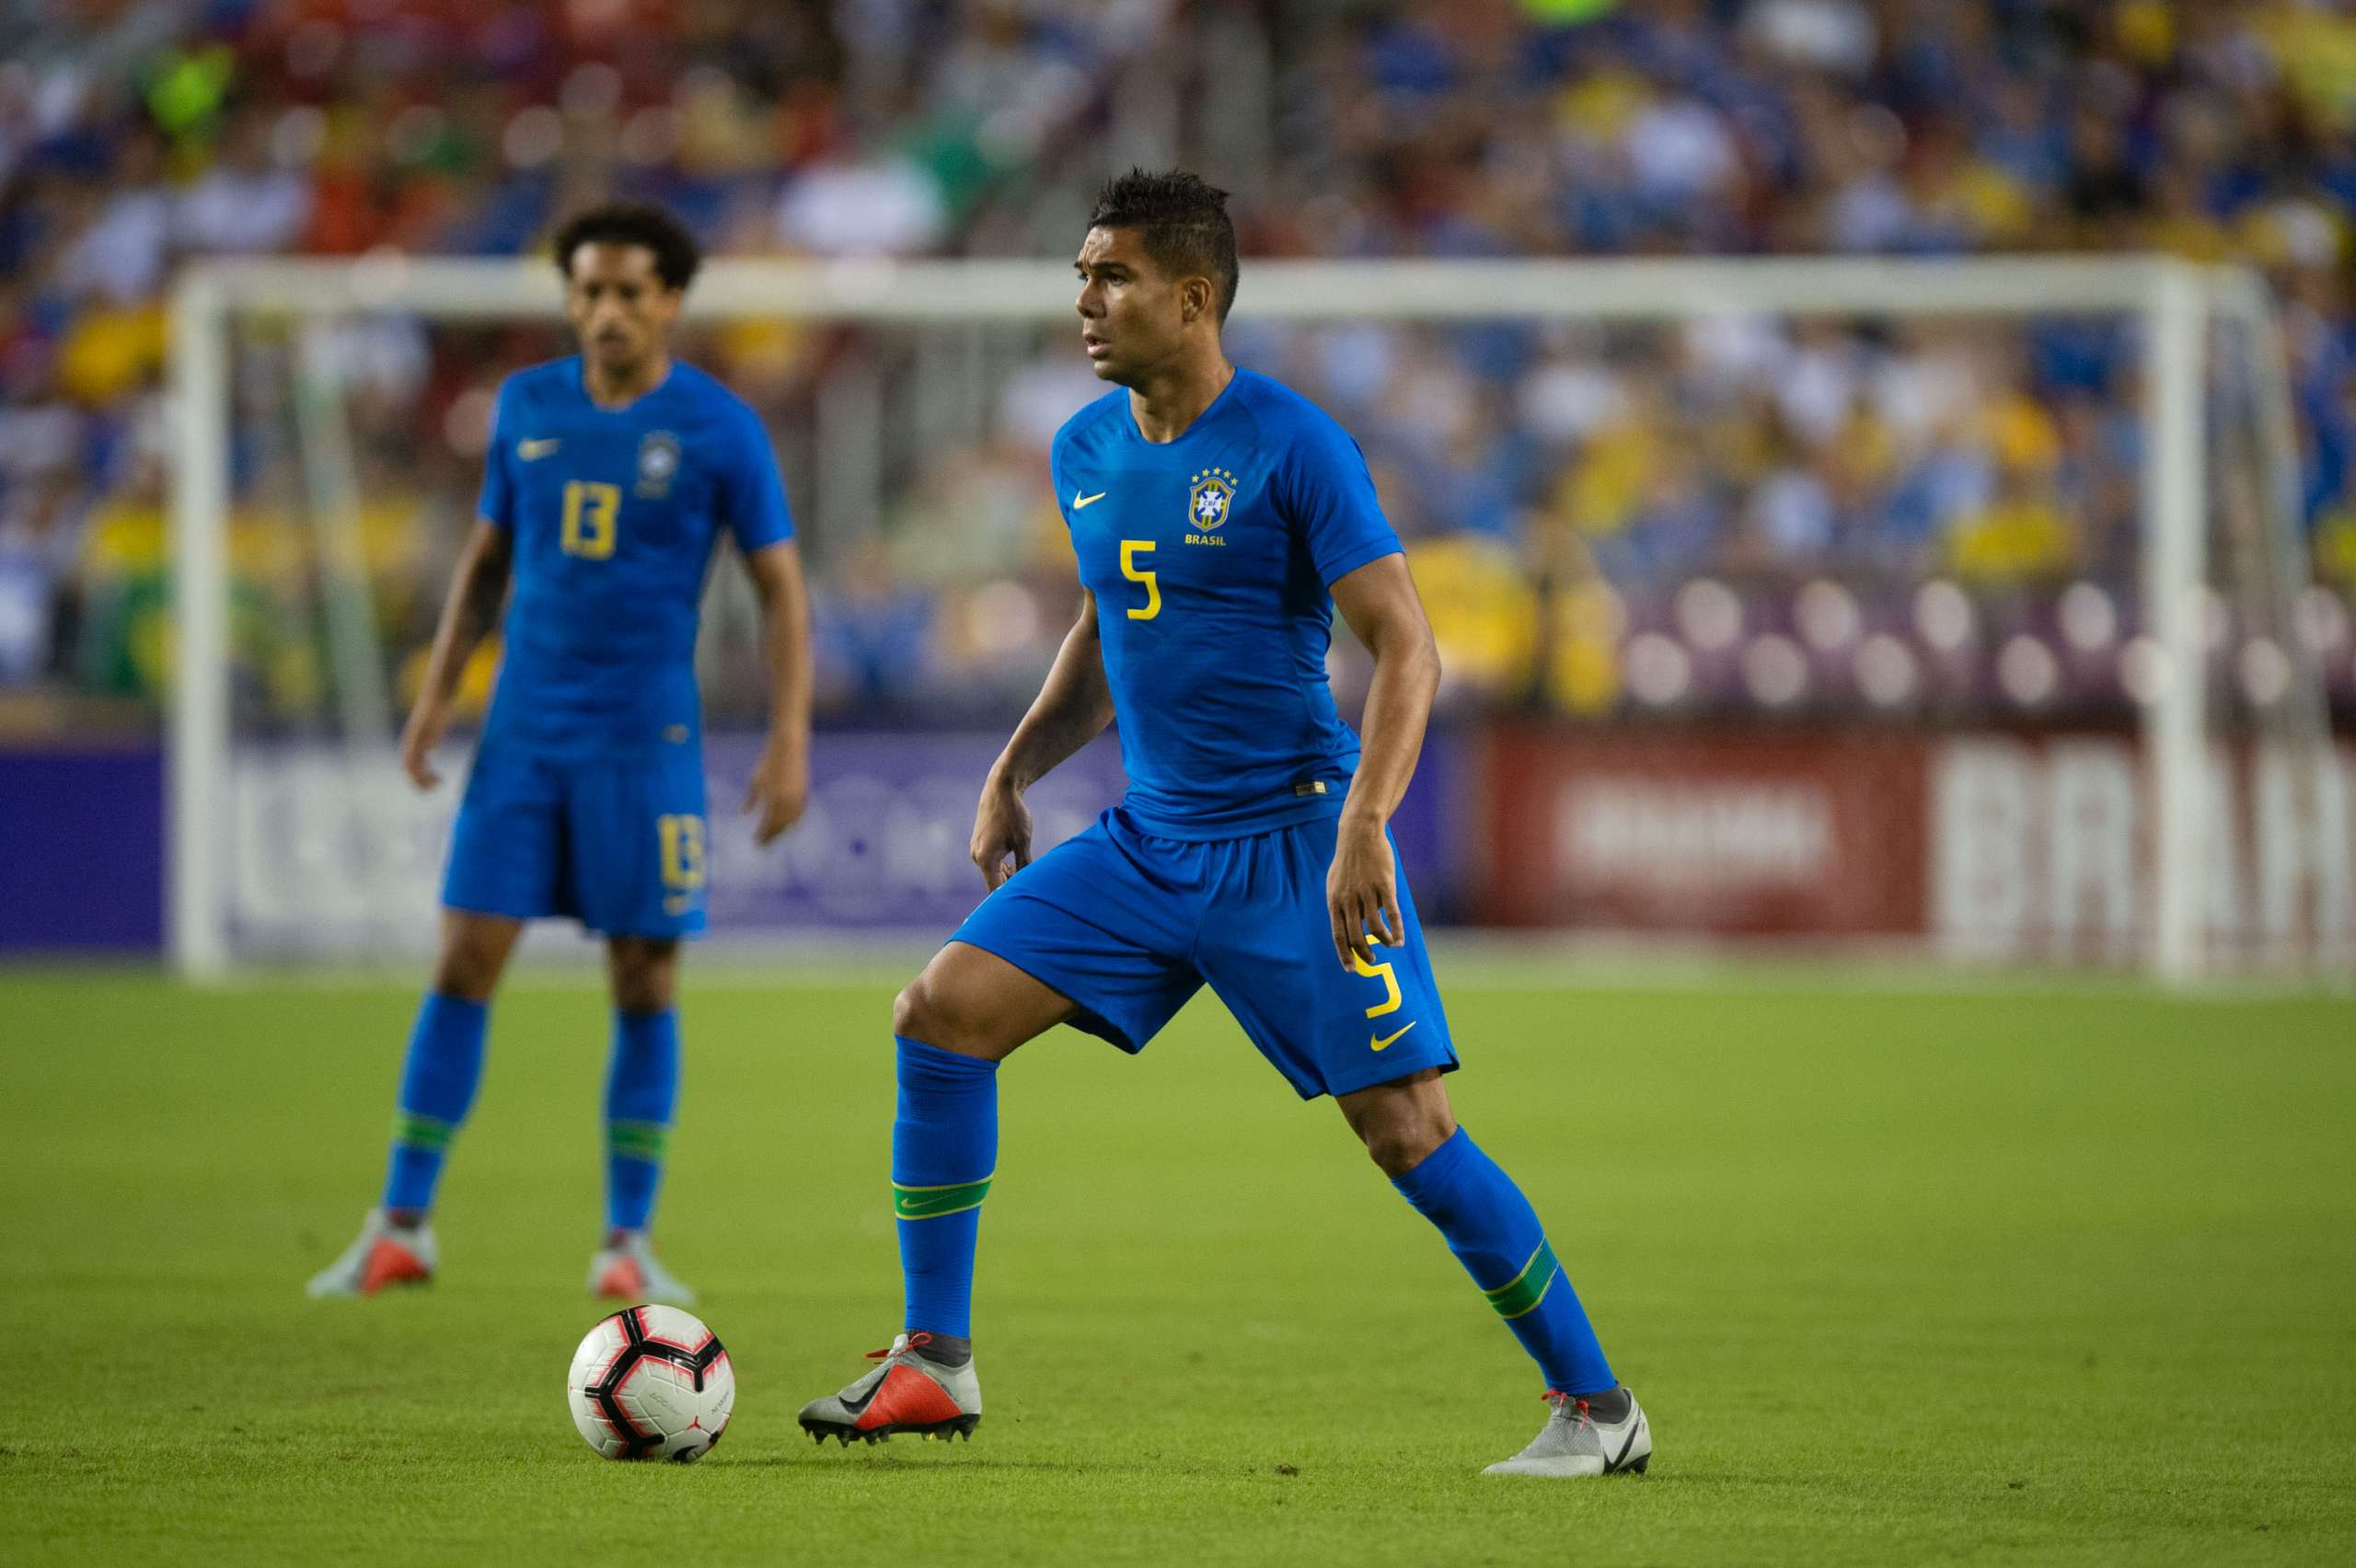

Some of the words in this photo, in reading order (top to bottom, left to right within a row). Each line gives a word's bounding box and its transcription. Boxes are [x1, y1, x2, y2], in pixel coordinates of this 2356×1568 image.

[560, 479, 621, 560] 13
[1184, 534, 1227, 547] BRASIL
[1119, 539, 1162, 621] 5
[657, 813, 707, 889] 13
[1349, 932, 1403, 1020] 5
